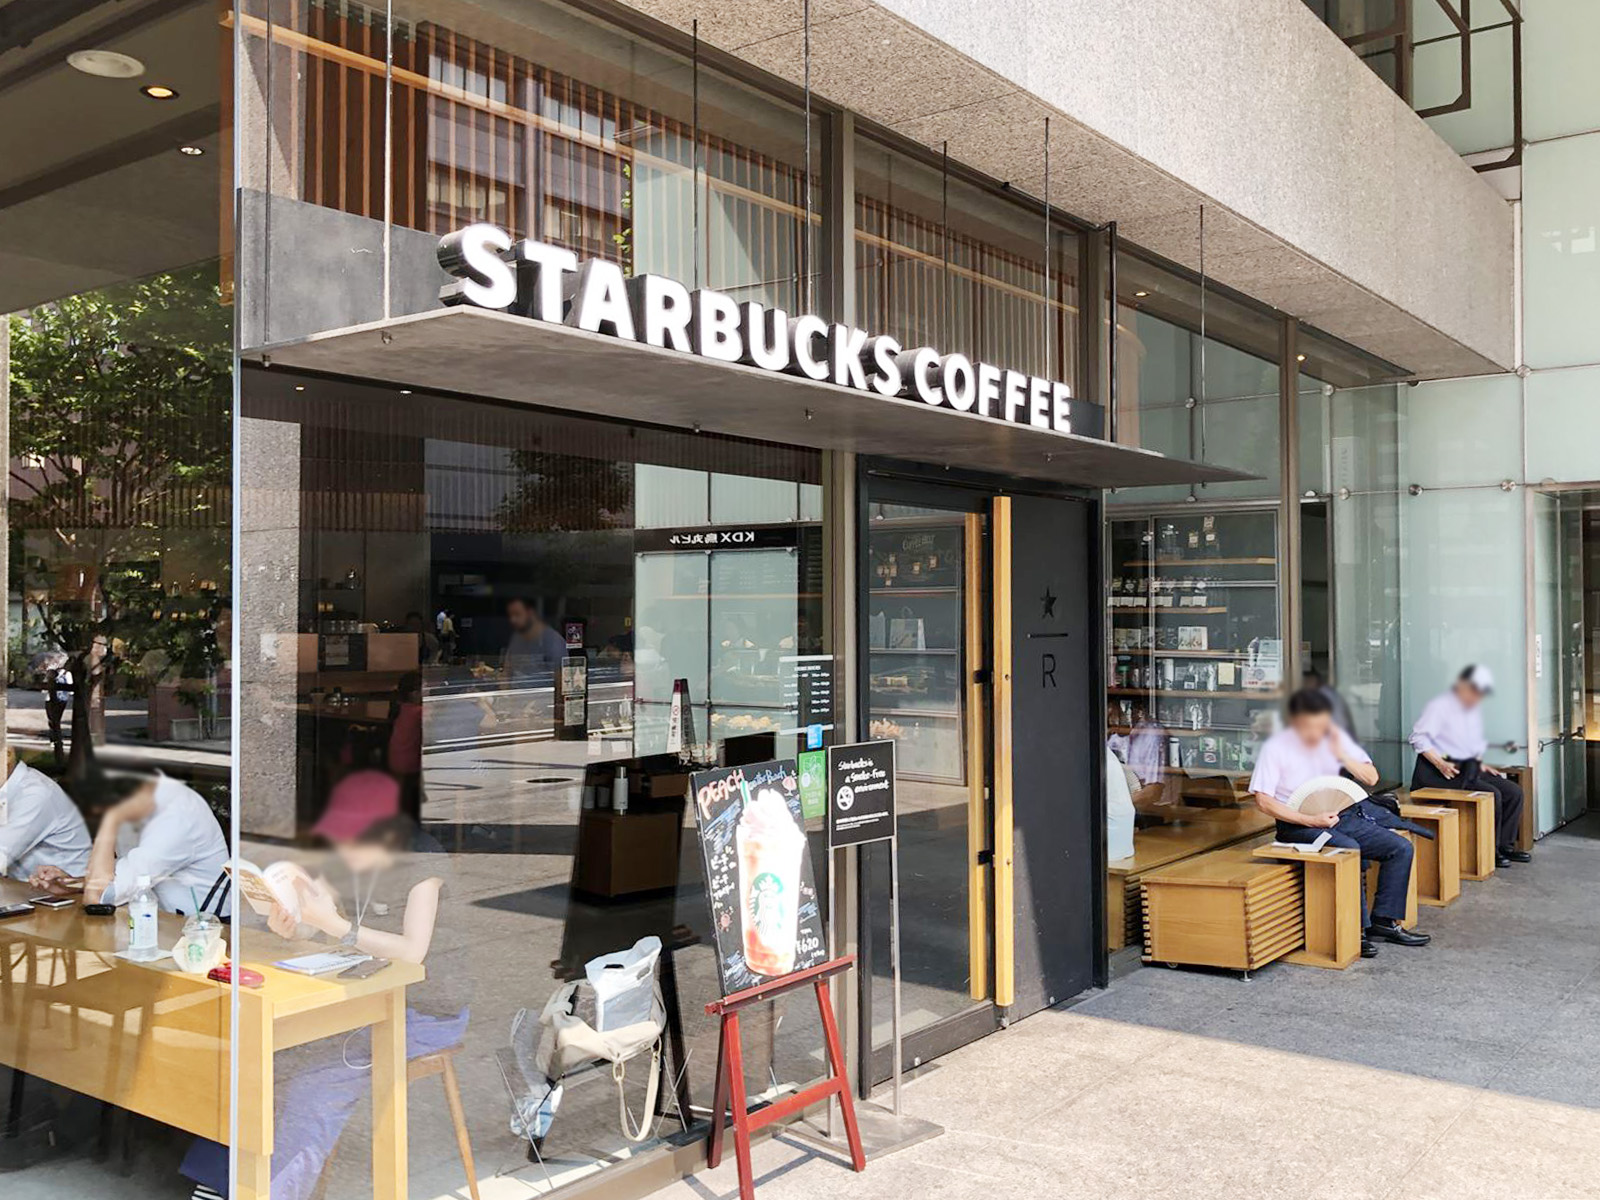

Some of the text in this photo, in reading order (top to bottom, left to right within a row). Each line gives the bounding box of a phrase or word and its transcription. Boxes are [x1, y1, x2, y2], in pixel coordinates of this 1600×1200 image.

[438, 222, 1073, 434] STARBUCKS COFFEE
[1042, 653, 1057, 688] R
[697, 768, 745, 820] PEACH
